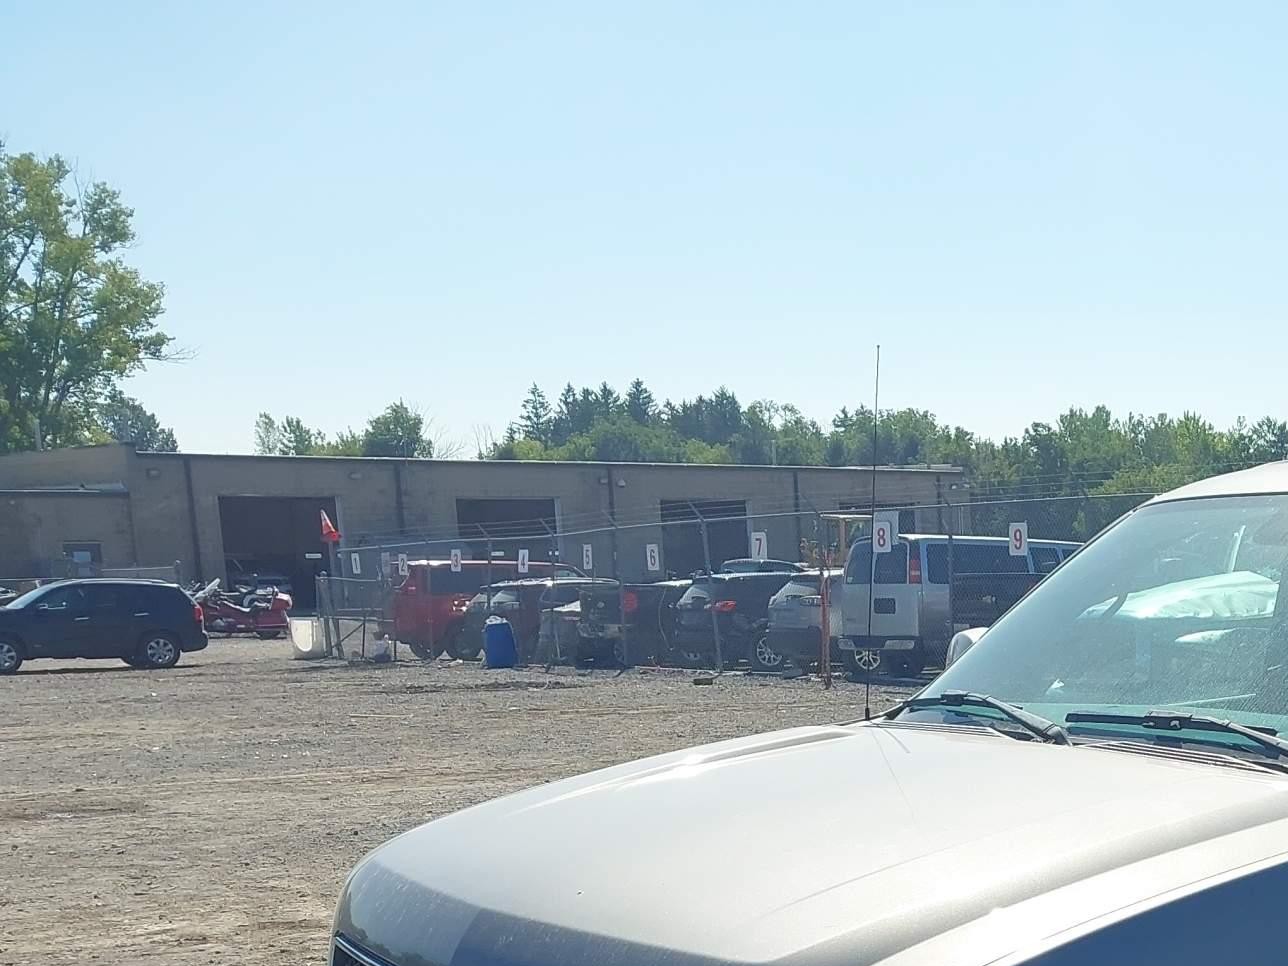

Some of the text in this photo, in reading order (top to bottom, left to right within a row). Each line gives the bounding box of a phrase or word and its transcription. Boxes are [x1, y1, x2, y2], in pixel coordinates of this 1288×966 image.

[754, 537, 762, 556] 7
[877, 527, 886, 548] 8
[1013, 528, 1023, 550] 9
[584, 551, 590, 566] 5
[649, 549, 656, 566] 6
